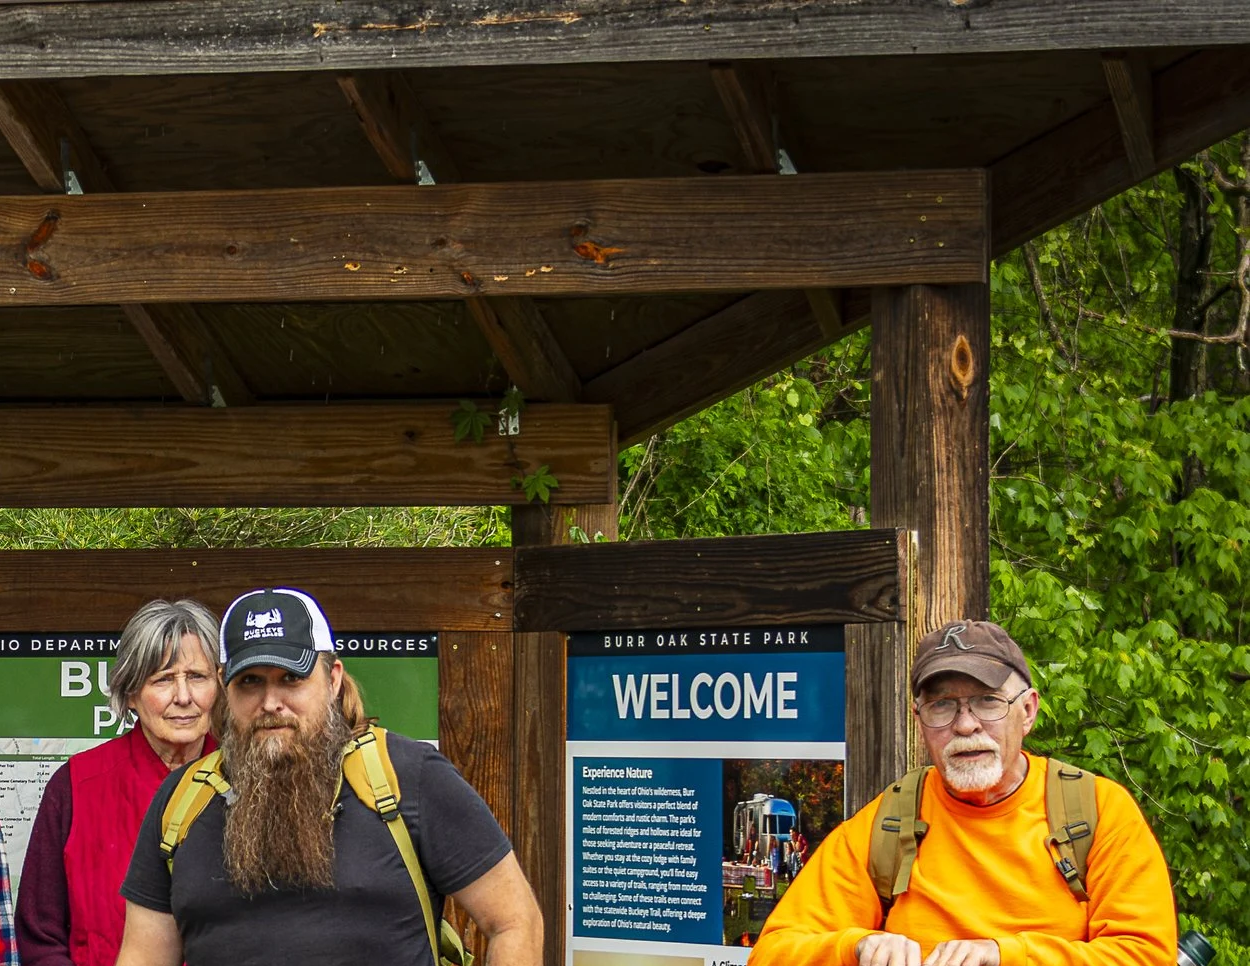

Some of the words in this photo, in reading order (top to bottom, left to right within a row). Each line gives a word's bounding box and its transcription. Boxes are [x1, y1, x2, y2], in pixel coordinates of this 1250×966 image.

[604, 635, 645, 648] BURR
[657, 634, 688, 647] OAK
[699, 632, 751, 646] STATE
[763, 631, 809, 645] PARK
[934, 625, 975, 651] R
[612, 671, 798, 719] WELCOME
[582, 766, 624, 781] Experience
[626, 767, 653, 779] Nature
[582, 785, 601, 795] Nestled
[607, 785, 616, 795] the
[616, 786, 631, 795] heart
[637, 786, 653, 796] Ohio's
[653, 786, 682, 797] wilderness,
[682, 787, 695, 797] Burr
[582, 916, 610, 929] exploration
[616, 918, 633, 929] Ohio's
[632, 919, 651, 930] natural
[651, 920, 671, 933] beauty.
